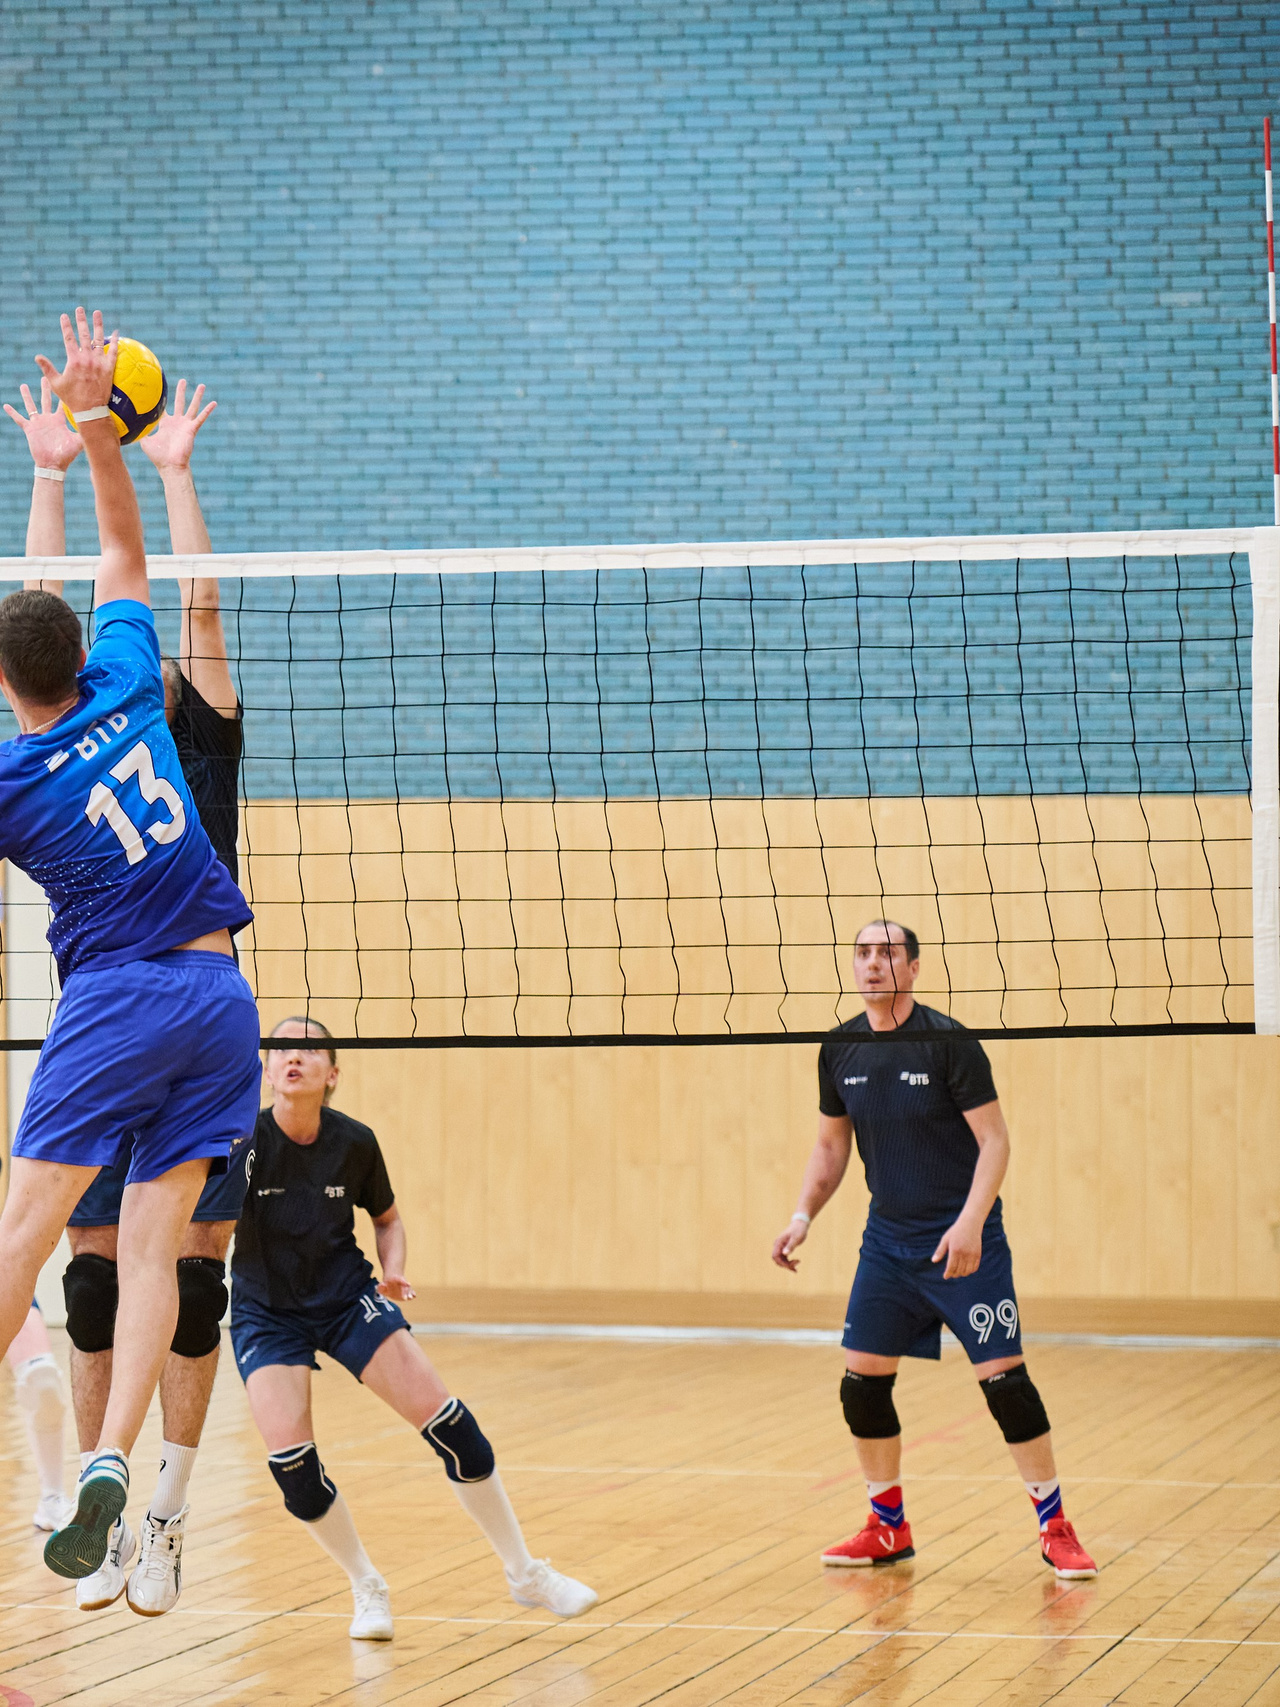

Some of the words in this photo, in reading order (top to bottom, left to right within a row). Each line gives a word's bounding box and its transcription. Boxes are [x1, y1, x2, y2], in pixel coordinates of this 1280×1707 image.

[84, 740, 186, 866] 13
[909, 1073, 929, 1086] ВТБ
[969, 1299, 1018, 1344] 99
